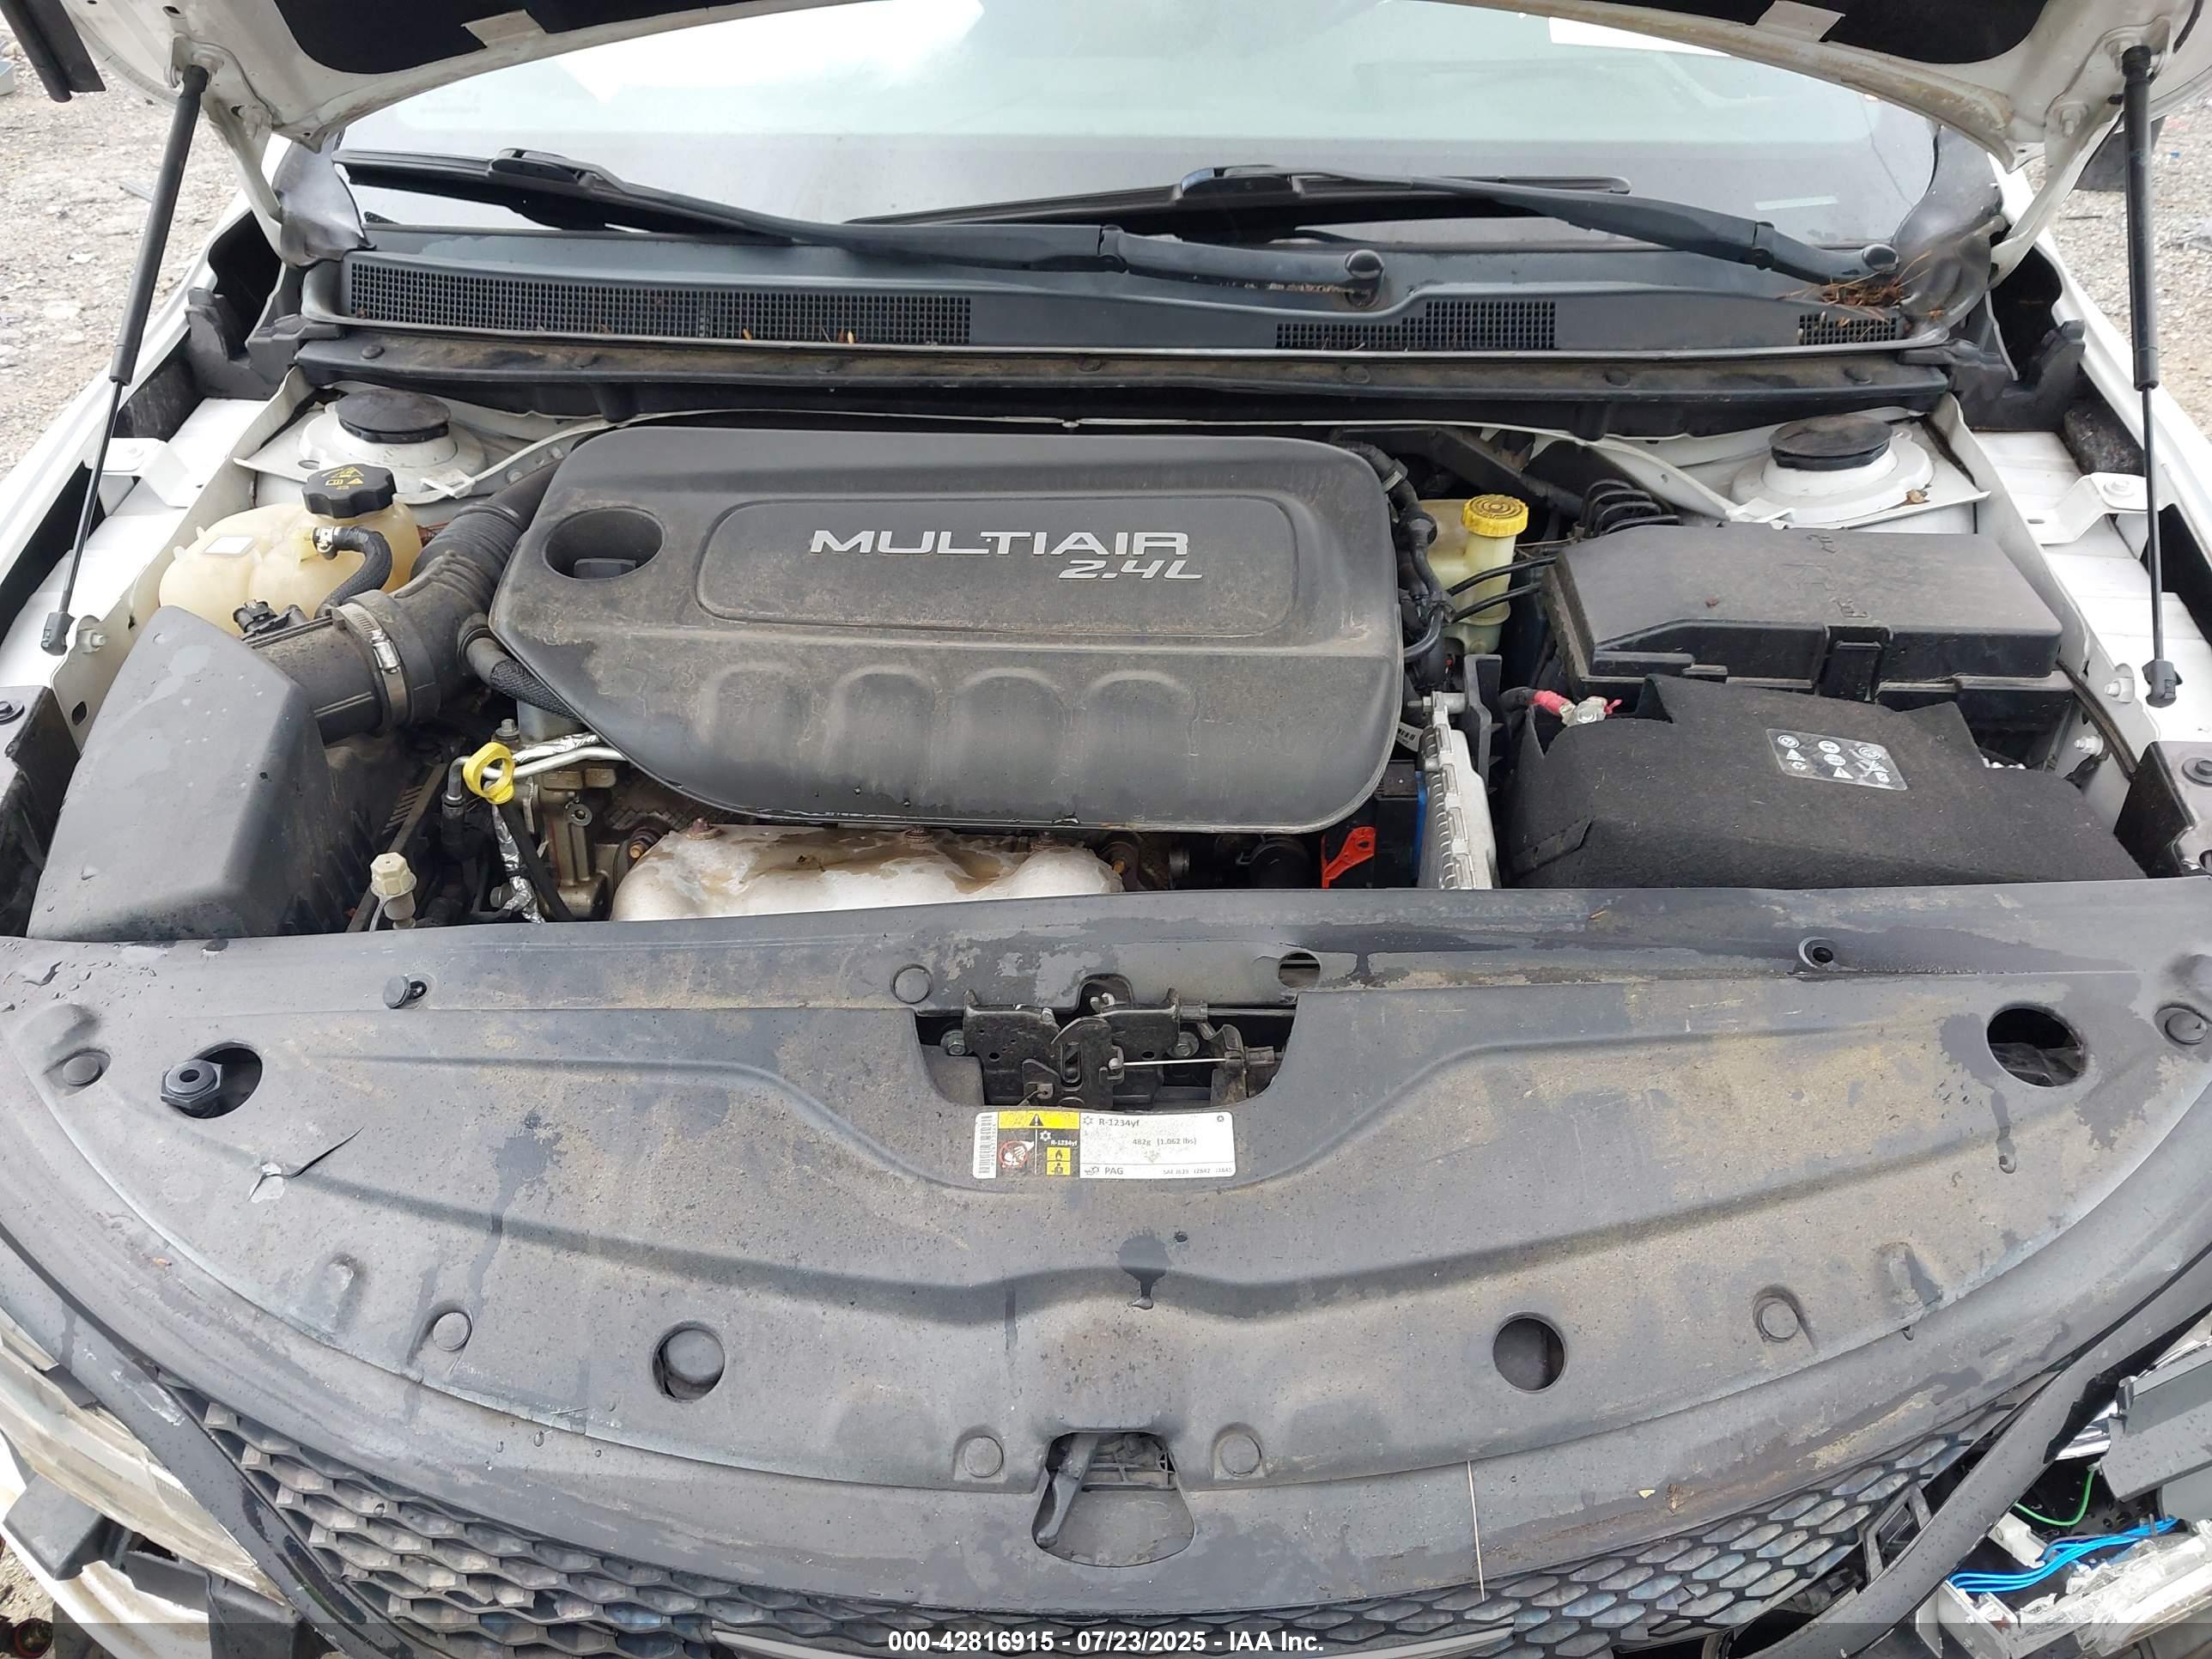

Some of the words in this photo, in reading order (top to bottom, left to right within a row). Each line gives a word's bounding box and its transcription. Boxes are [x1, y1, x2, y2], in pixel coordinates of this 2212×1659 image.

[810, 530, 1189, 556] MULTIAIR
[1058, 560, 1203, 580] 2.4L
[1098, 1118, 1140, 1127] R-1234yf
